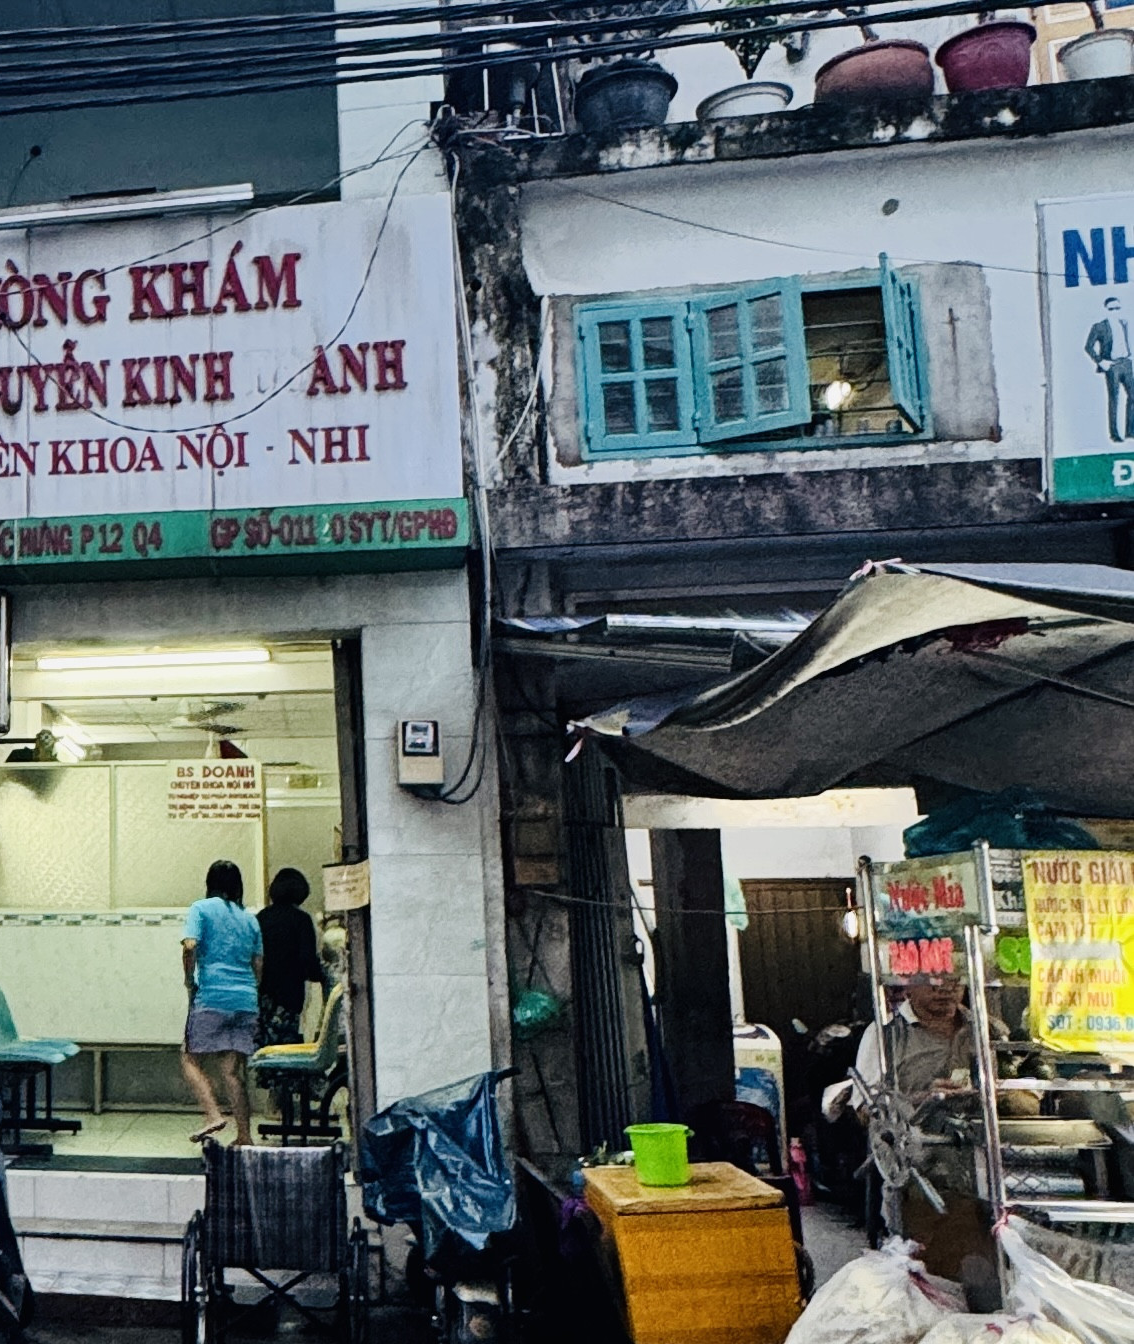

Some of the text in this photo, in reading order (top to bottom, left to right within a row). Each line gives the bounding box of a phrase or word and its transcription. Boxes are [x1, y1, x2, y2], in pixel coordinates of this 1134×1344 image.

[129, 240, 302, 321] KHÁM
[121, 351, 235, 407] KINH
[48, 435, 164, 476] KHOA
[176, 423, 250, 476] NỘI
[287, 424, 371, 465] NHI
[80, 524, 95, 554] P
[98, 523, 124, 554] 12
[132, 520, 163, 557] Q4
[211, 517, 241, 550] GP
[202, 765, 256, 778] DOANH
